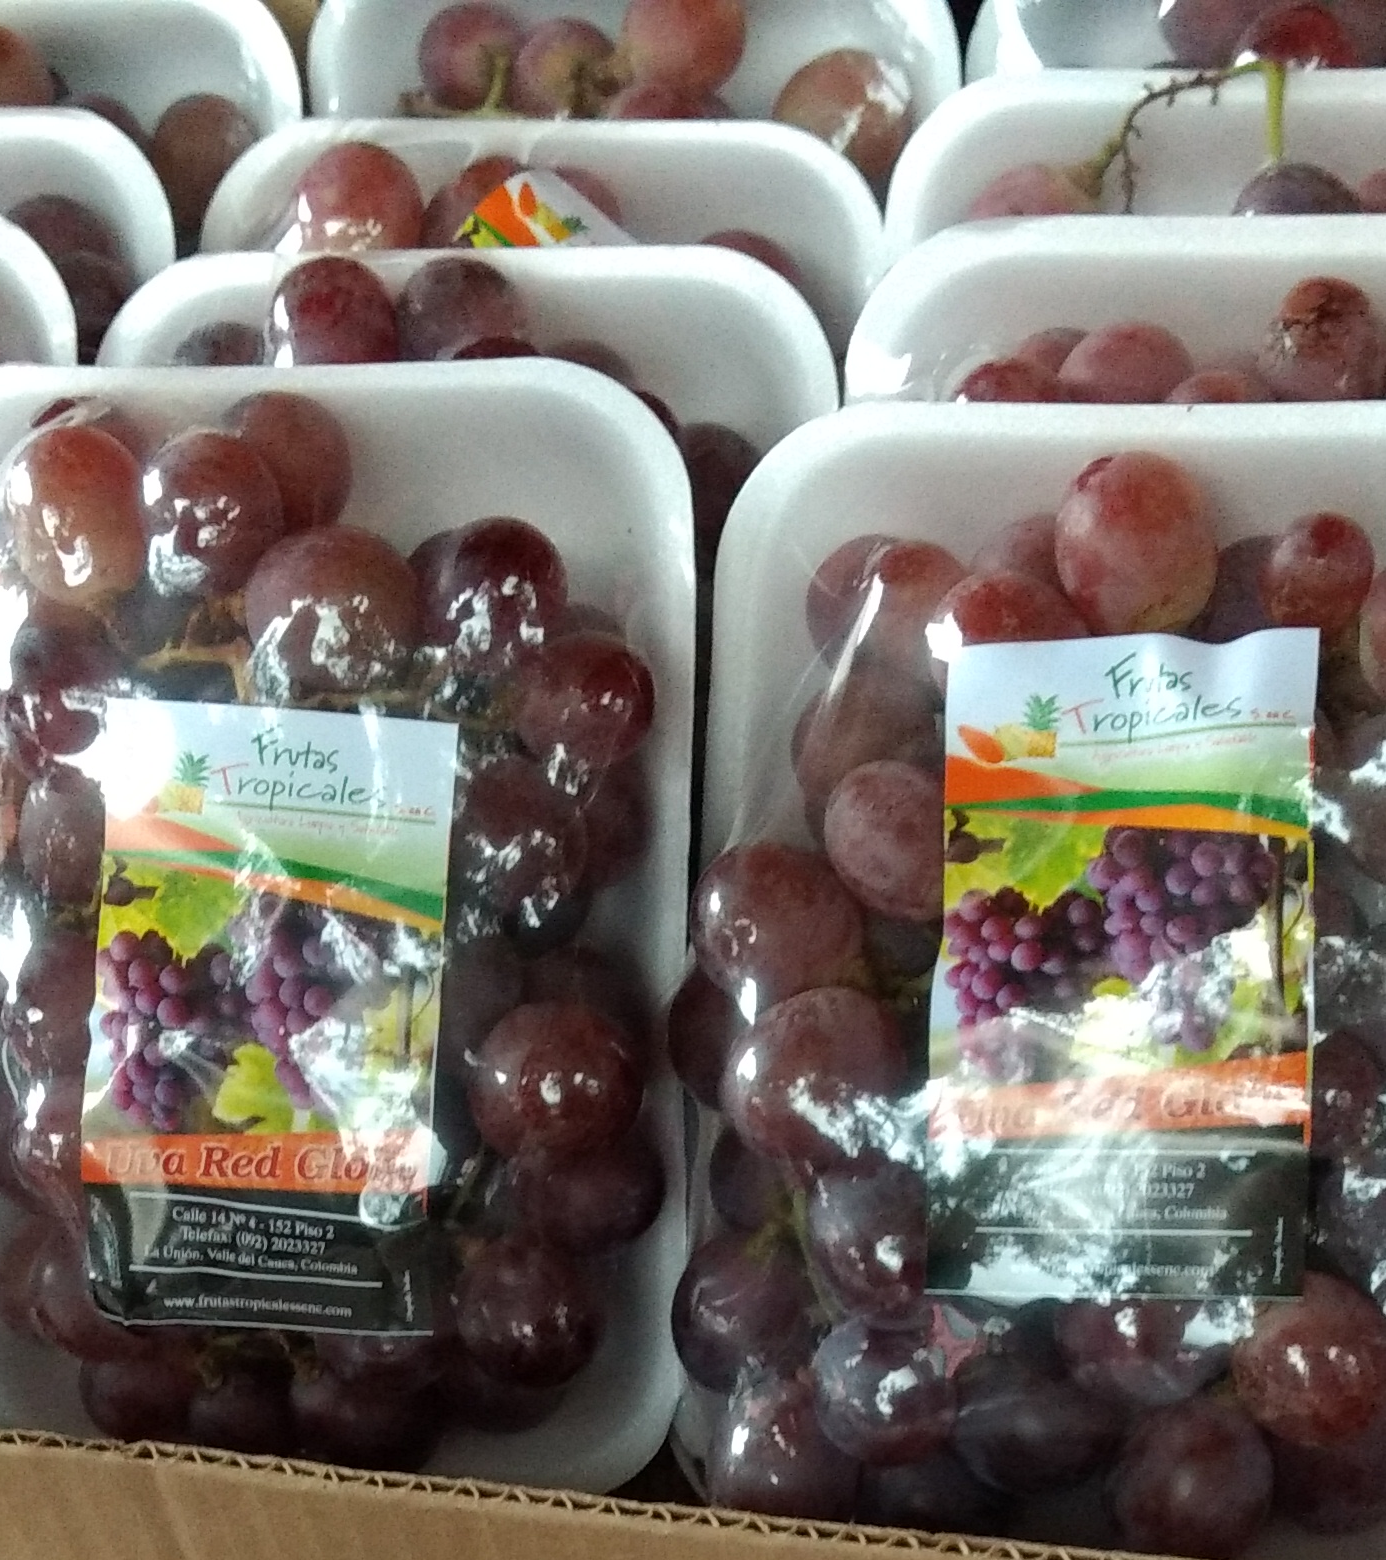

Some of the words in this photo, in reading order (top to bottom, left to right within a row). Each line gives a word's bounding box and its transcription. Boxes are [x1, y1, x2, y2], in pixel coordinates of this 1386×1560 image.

[1062, 694, 1242, 744] Tropicales
[251, 727, 339, 774] Frutas
[200, 1145, 282, 1180] Red
[297, 1144, 417, 1184] Glo
[172, 1206, 207, 1224] Calle
[211, 1210, 226, 1225] 14
[268, 1218, 292, 1235] 152
[295, 1220, 323, 1238] Piso
[325, 1224, 336, 1240] 2
[207, 1248, 237, 1264] Valle
[238, 1251, 256, 1267] del
[301, 1258, 359, 1276] Colombia
[235, 1231, 268, 1251] (092)
[271, 1236, 327, 1256] 2023327
